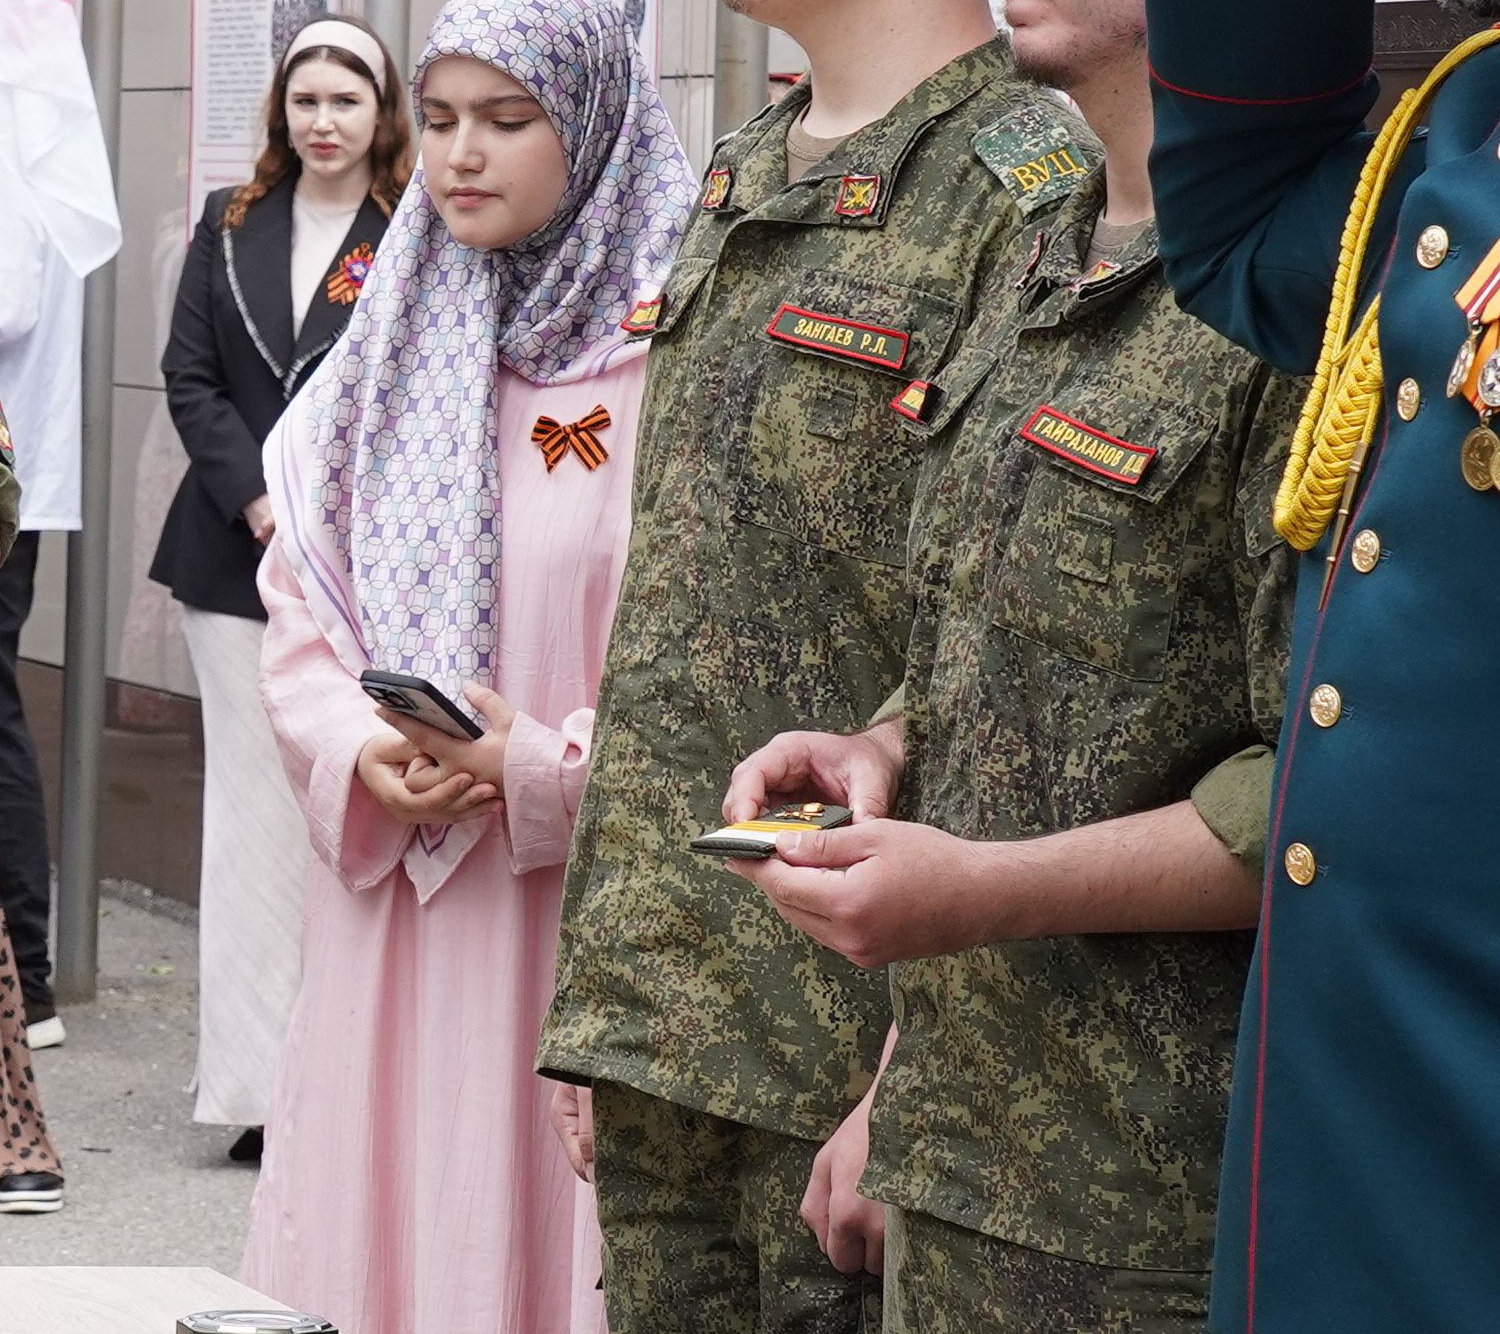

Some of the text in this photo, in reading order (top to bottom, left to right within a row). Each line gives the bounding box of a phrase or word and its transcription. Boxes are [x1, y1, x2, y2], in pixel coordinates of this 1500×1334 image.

[1009, 149, 1089, 192] ВУЦ
[794, 318, 855, 346] ЗАНГАЕВ
[1033, 416, 1125, 467] ГАЙРАХАНОВ
